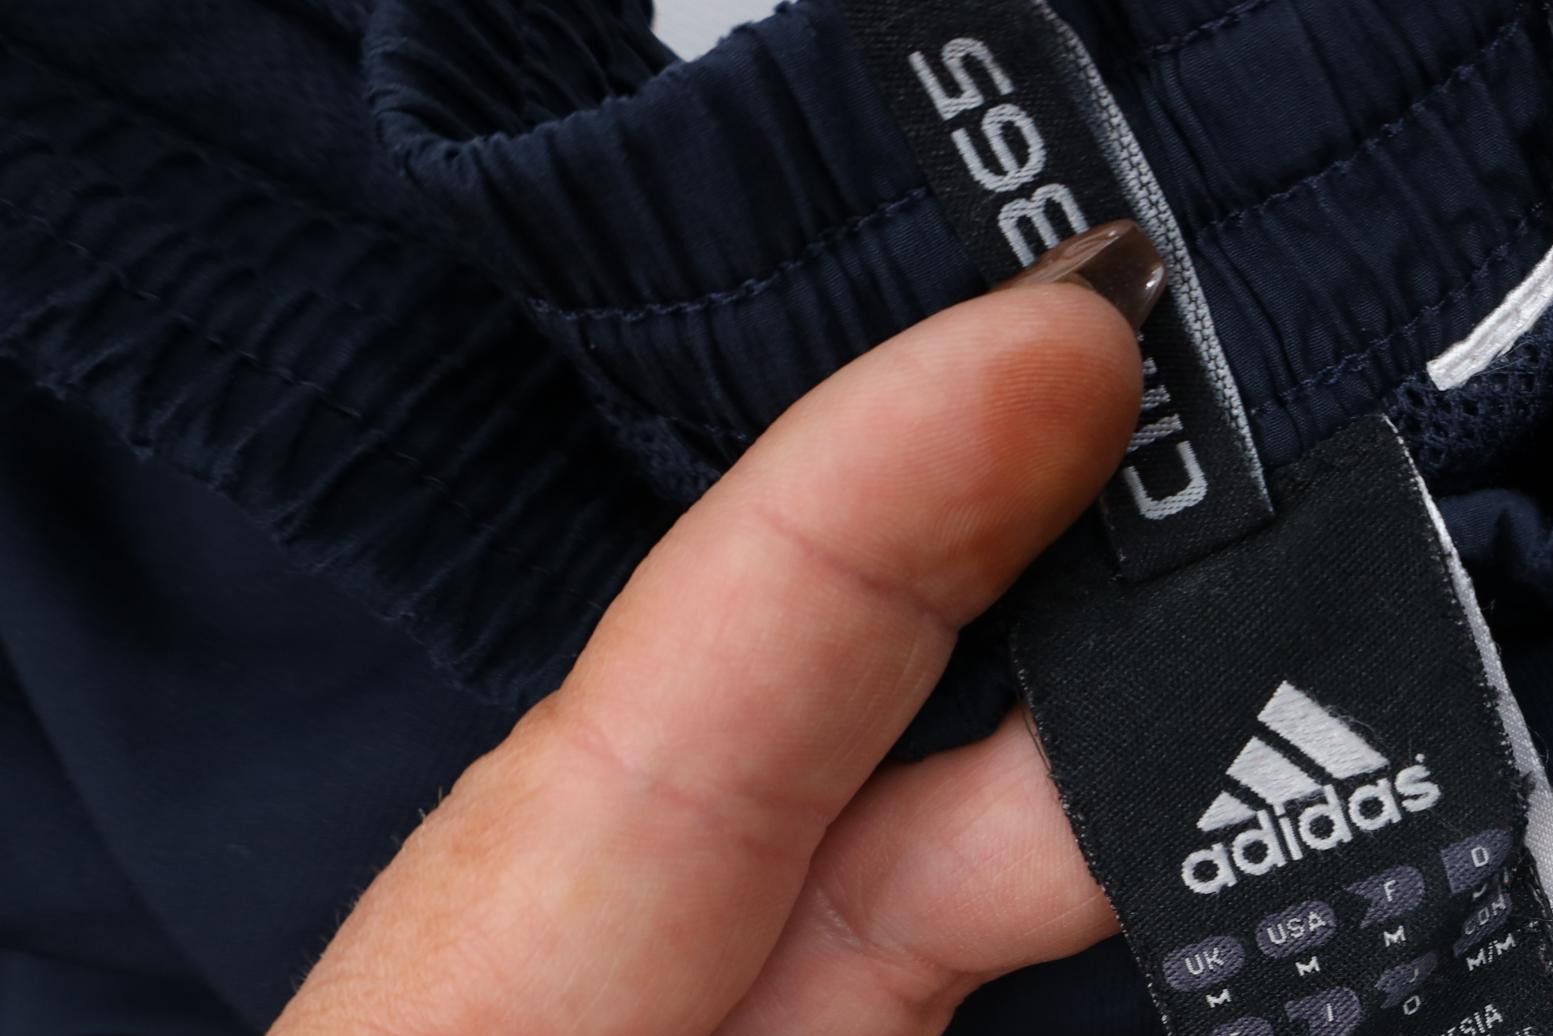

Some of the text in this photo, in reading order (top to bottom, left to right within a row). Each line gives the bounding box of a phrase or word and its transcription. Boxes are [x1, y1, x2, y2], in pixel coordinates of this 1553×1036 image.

[1180, 763, 1442, 895] adidas
[1185, 947, 1224, 976] UK
[1266, 911, 1327, 945] USA
[1383, 879, 1397, 902] F
[1206, 924, 1407, 1009] M M M
[1465, 932, 1517, 972] M/M
